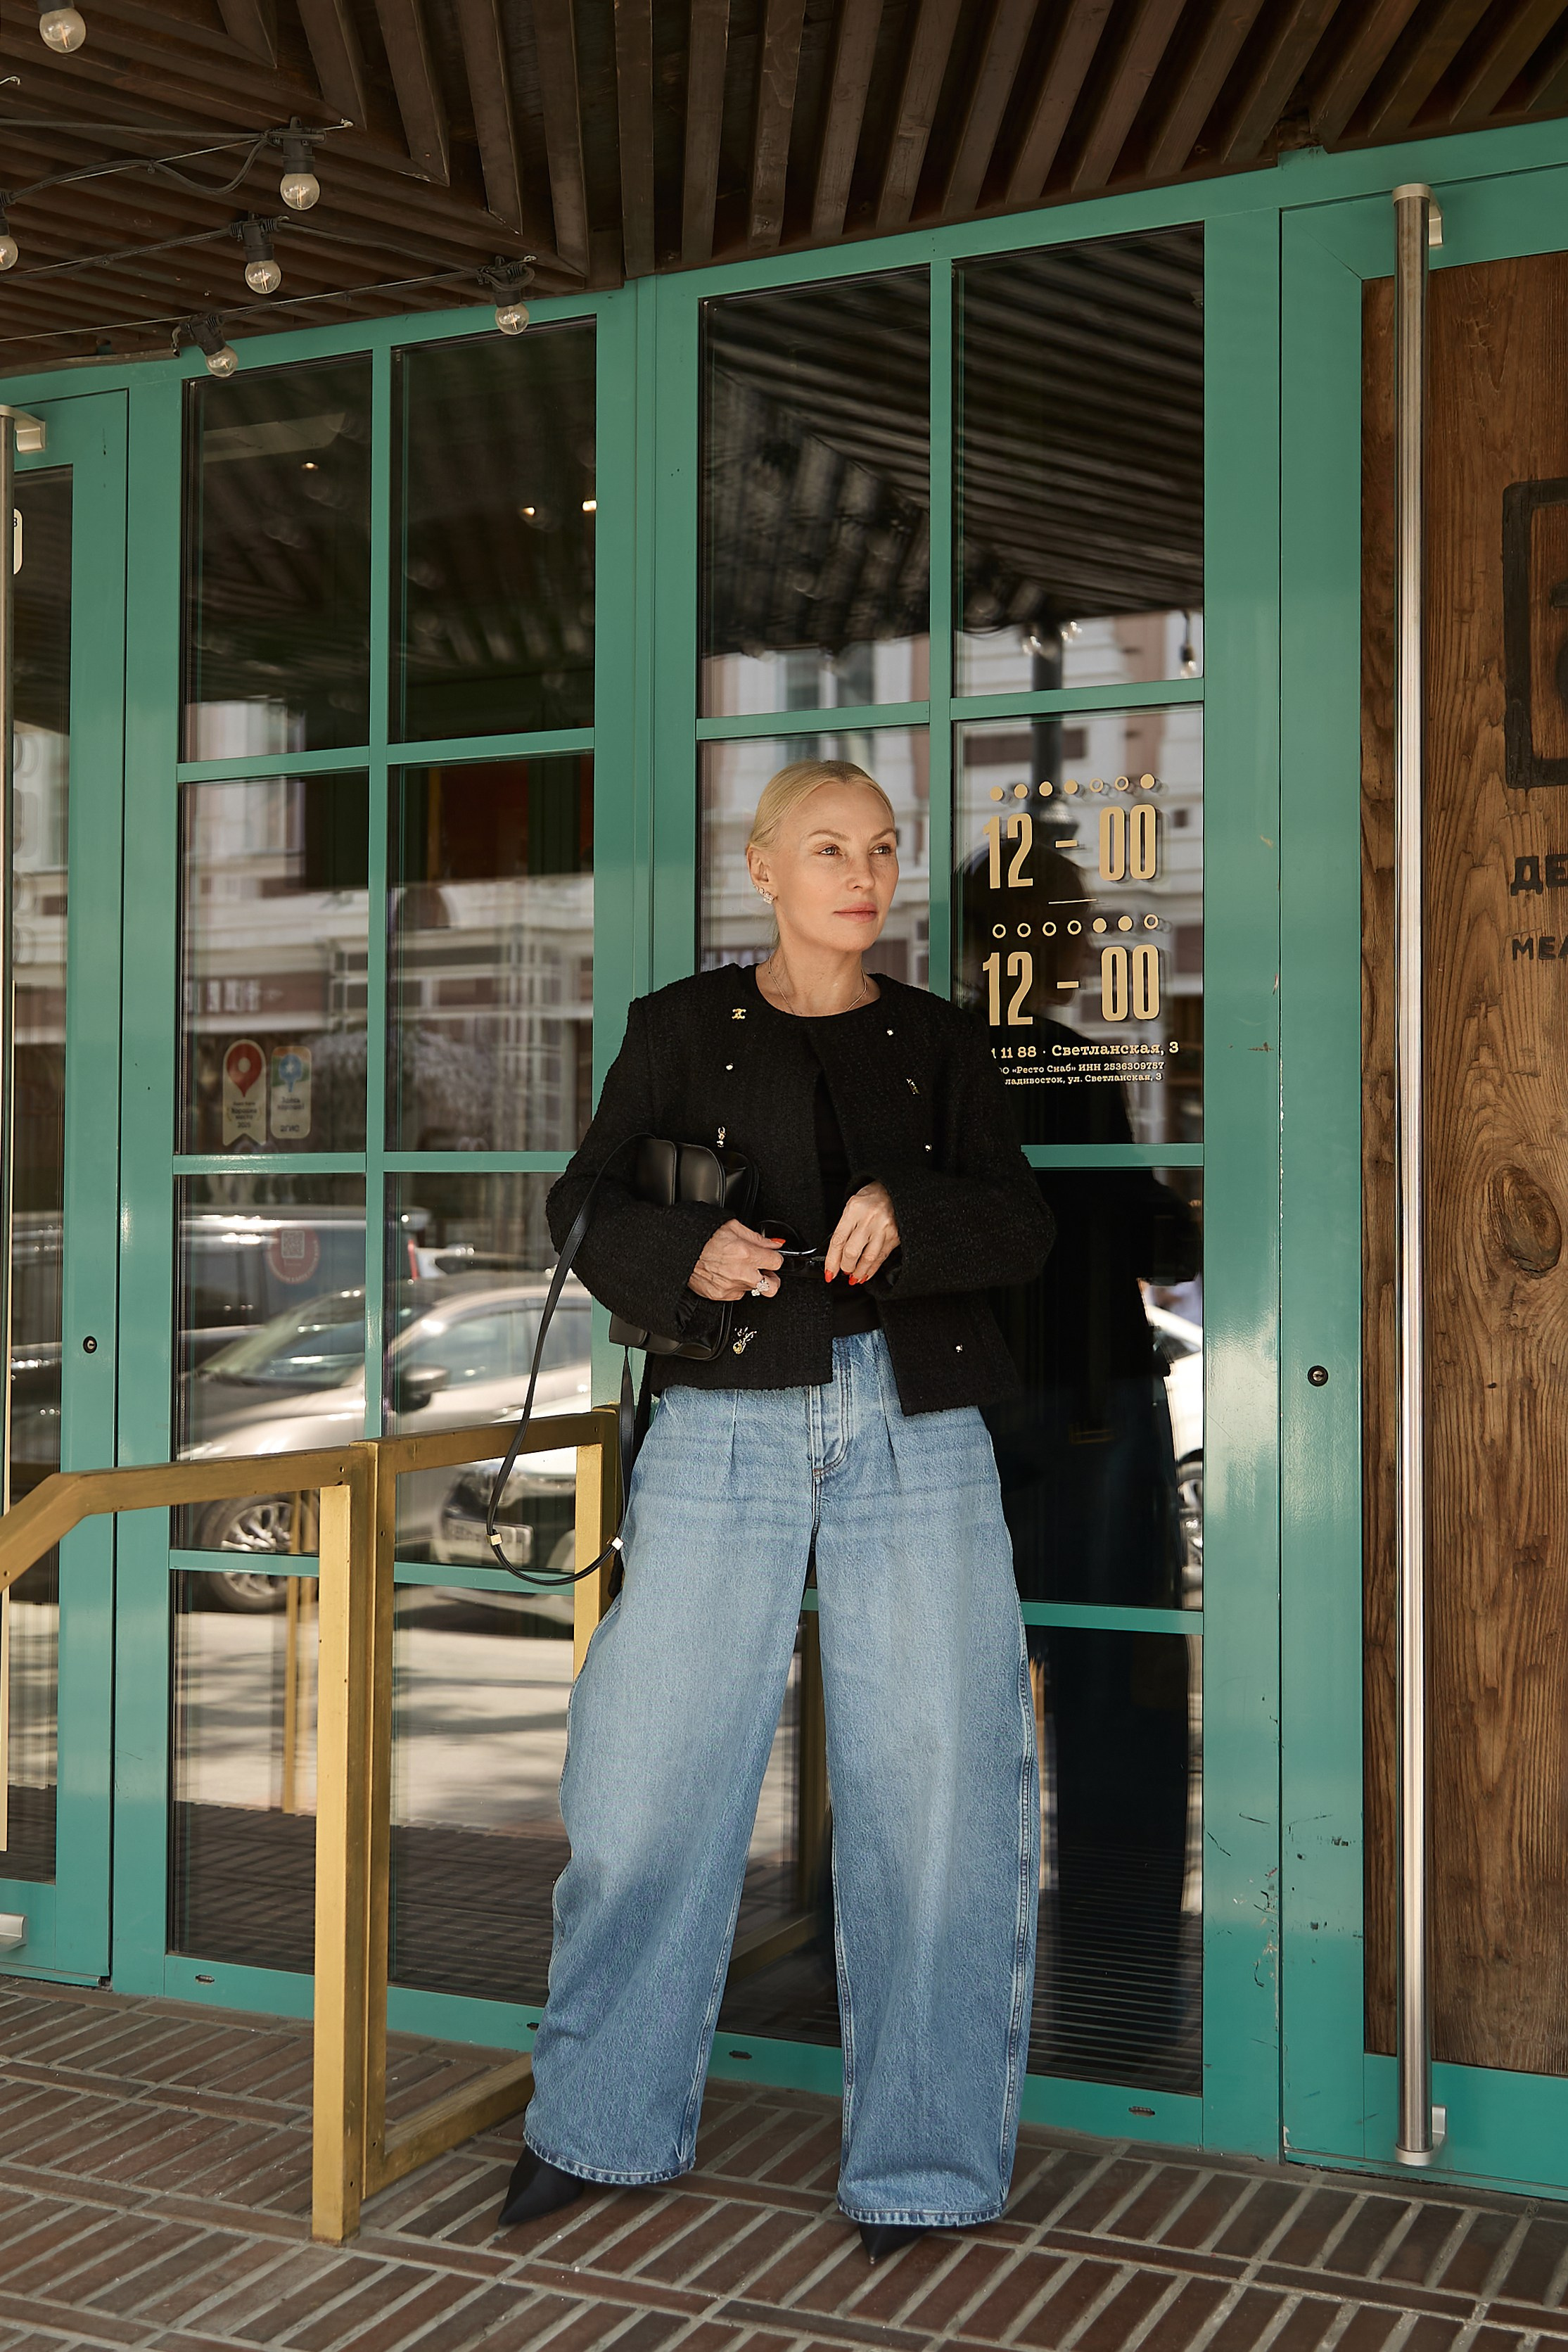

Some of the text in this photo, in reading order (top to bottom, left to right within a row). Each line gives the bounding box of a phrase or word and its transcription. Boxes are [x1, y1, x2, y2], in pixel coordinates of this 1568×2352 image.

[983, 813, 1033, 889] 12
[1099, 804, 1156, 882] 00
[983, 951, 1033, 1026] 12
[1101, 944, 1160, 1022] 00
[1000, 1047, 1013, 1059] 11
[1017, 1045, 1037, 1058] 88
[1052, 1044, 1164, 1056] Светланская,
[1168, 1041, 1179, 1053] 3
[1078, 1063, 1102, 1072] ИНН
[1104, 1061, 1165, 1071] 2536309757
[1005, 1072, 1162, 1086] ладивосток, ул. Светланская, 3
